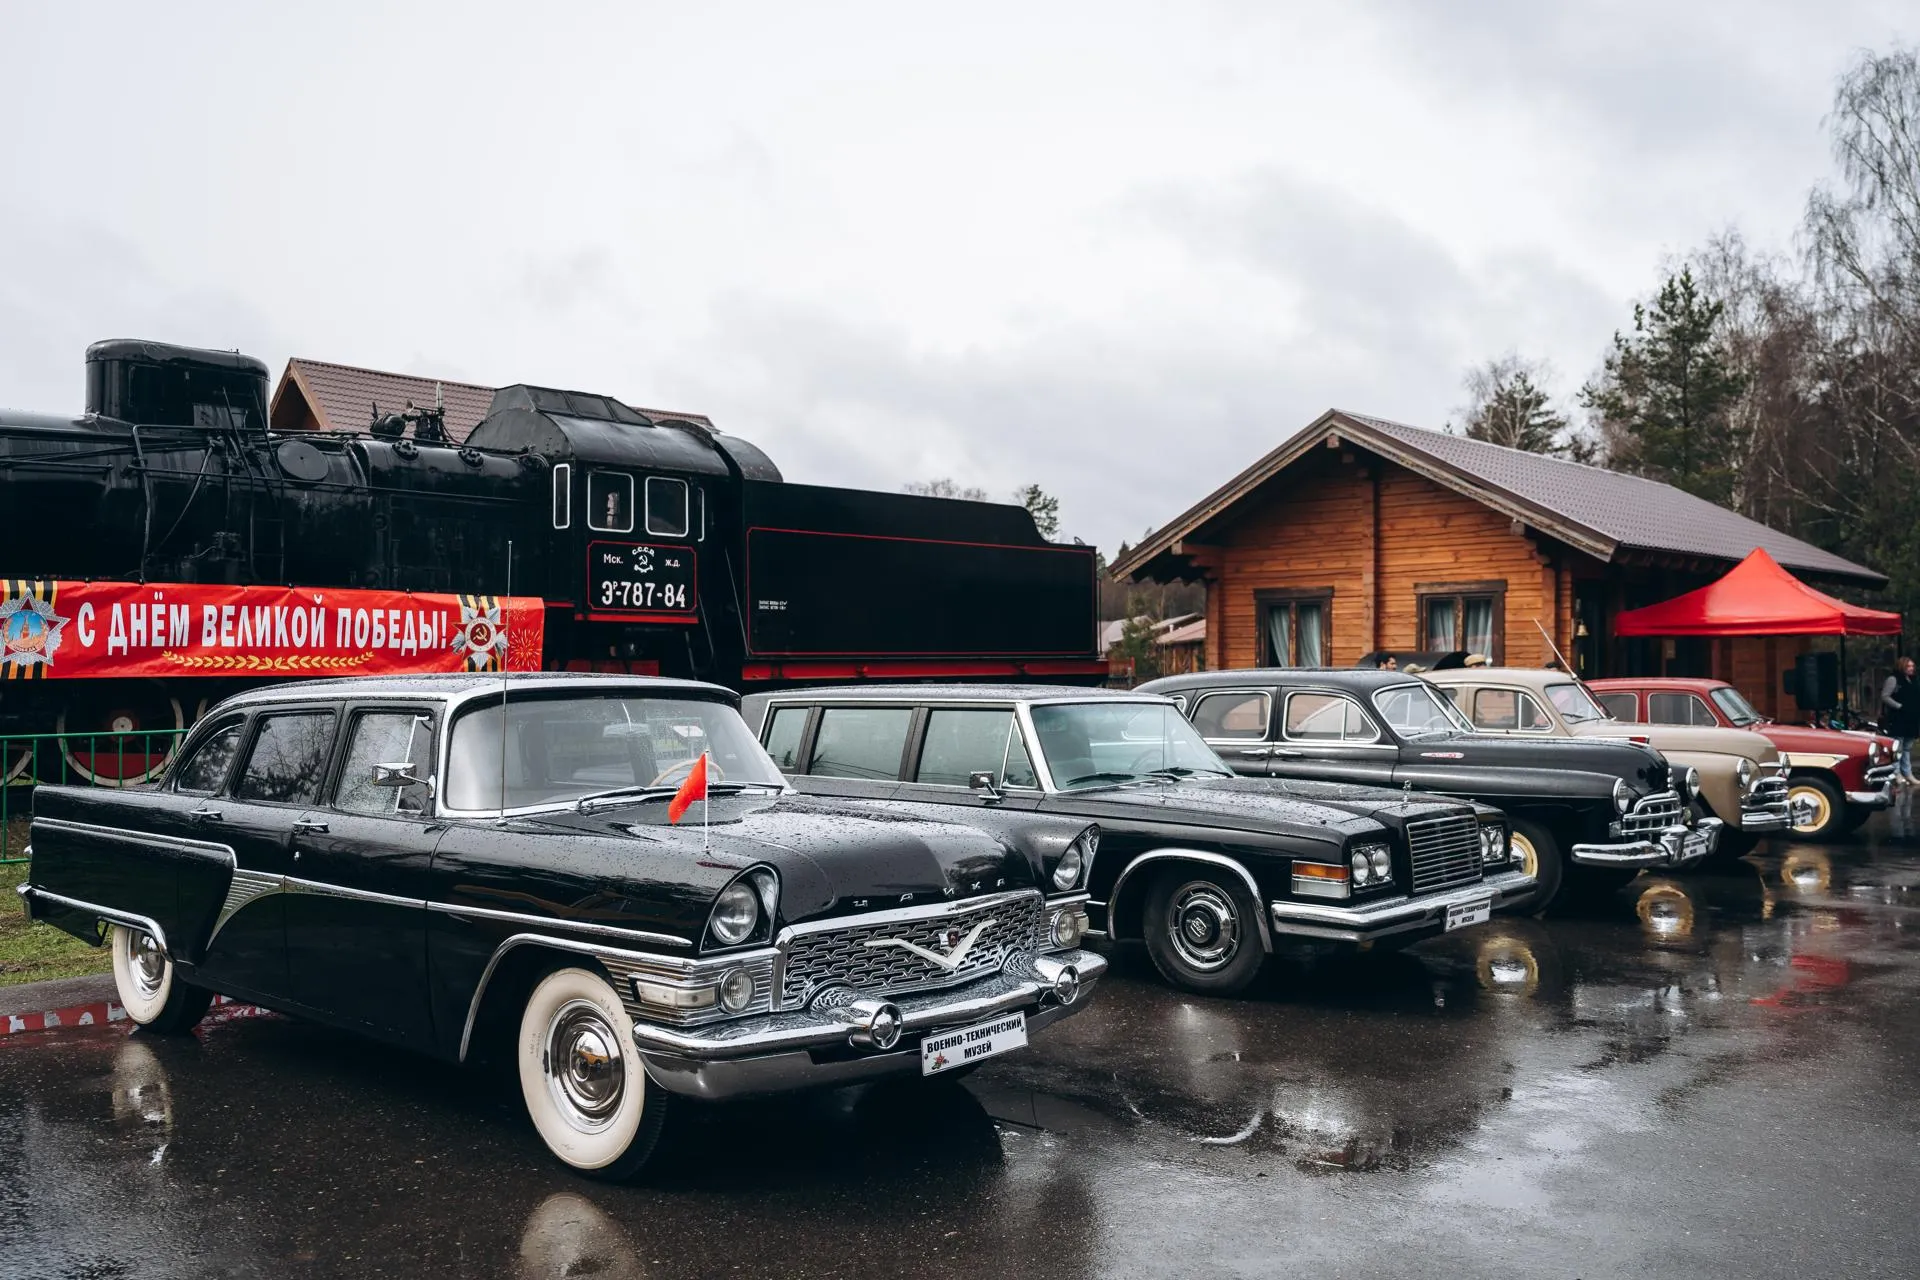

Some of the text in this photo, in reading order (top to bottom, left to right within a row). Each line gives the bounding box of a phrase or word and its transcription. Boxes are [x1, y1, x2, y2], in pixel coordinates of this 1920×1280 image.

[77, 601, 96, 648] С
[107, 591, 190, 656] ДНЁМ
[201, 594, 326, 648] ВЕЛИКОЙ
[336, 607, 448, 657] ПОБЕДЫ!
[926, 1016, 1023, 1054] ВОЕННО-ТЕХНИЧЕСКИЙ
[963, 1040, 993, 1059] МУЗЕЙ
